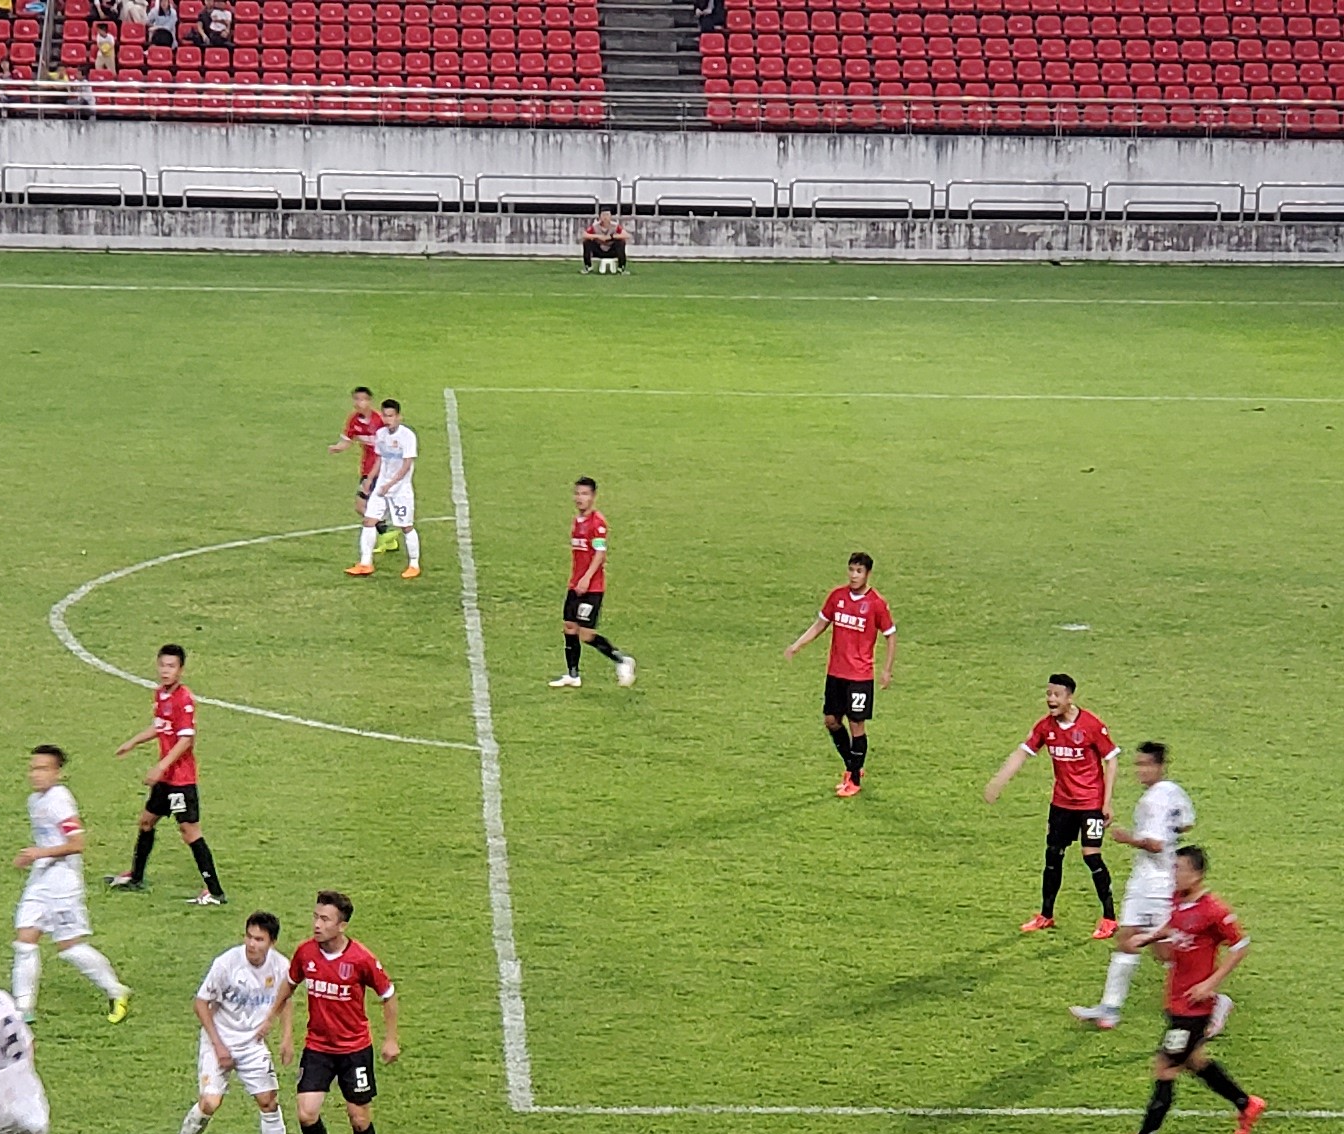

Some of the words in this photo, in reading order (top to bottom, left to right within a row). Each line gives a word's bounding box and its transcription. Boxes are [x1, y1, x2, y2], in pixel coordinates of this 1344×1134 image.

[851, 693, 867, 709] 22
[1086, 818, 1104, 836] 26
[355, 1067, 368, 1088] 5
